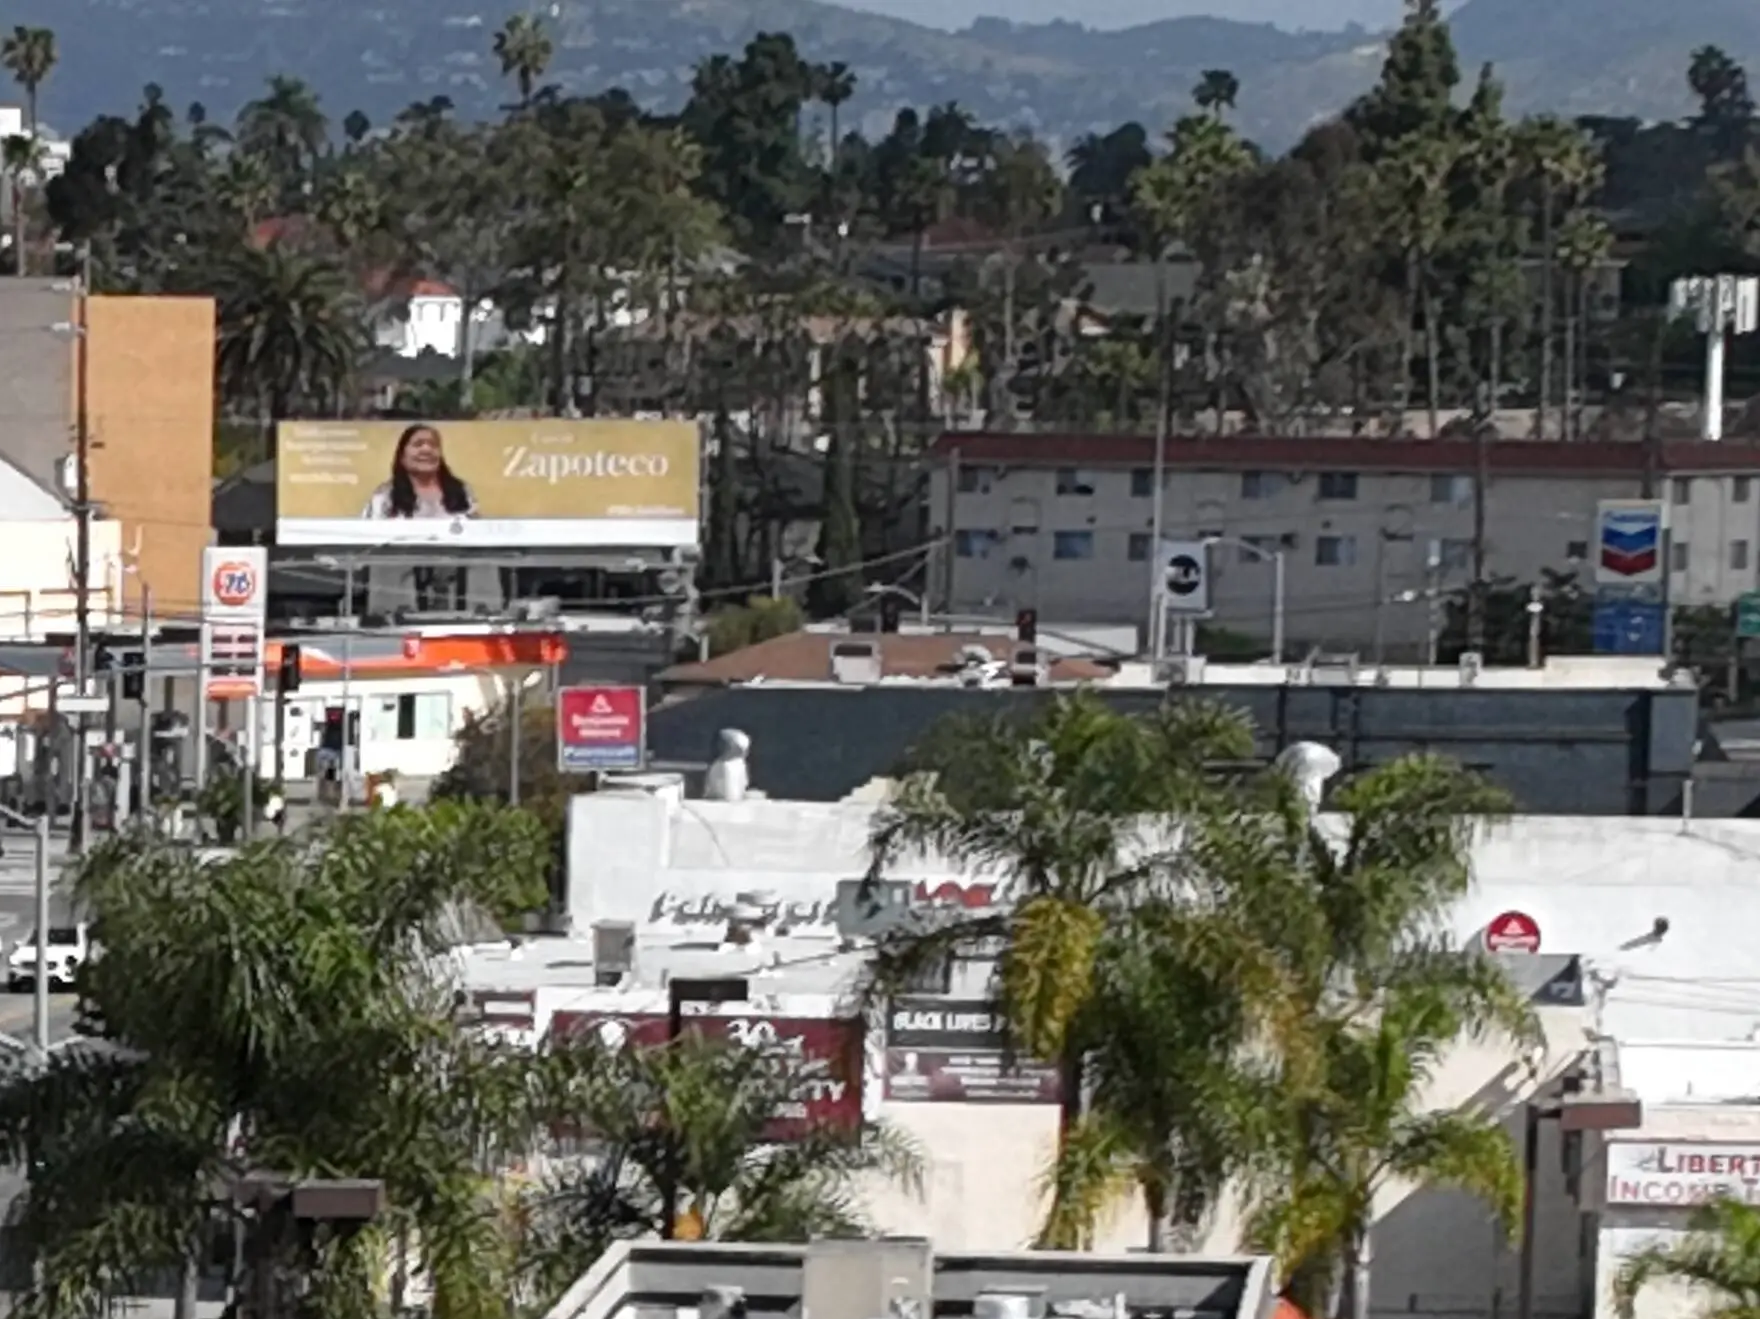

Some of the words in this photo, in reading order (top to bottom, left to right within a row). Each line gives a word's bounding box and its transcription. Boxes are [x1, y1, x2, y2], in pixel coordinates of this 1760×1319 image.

[502, 446, 669, 485] Zapoteco
[225, 572, 250, 594] 76
[894, 1011, 942, 1030] BLACK
[947, 1013, 991, 1030] LIVES
